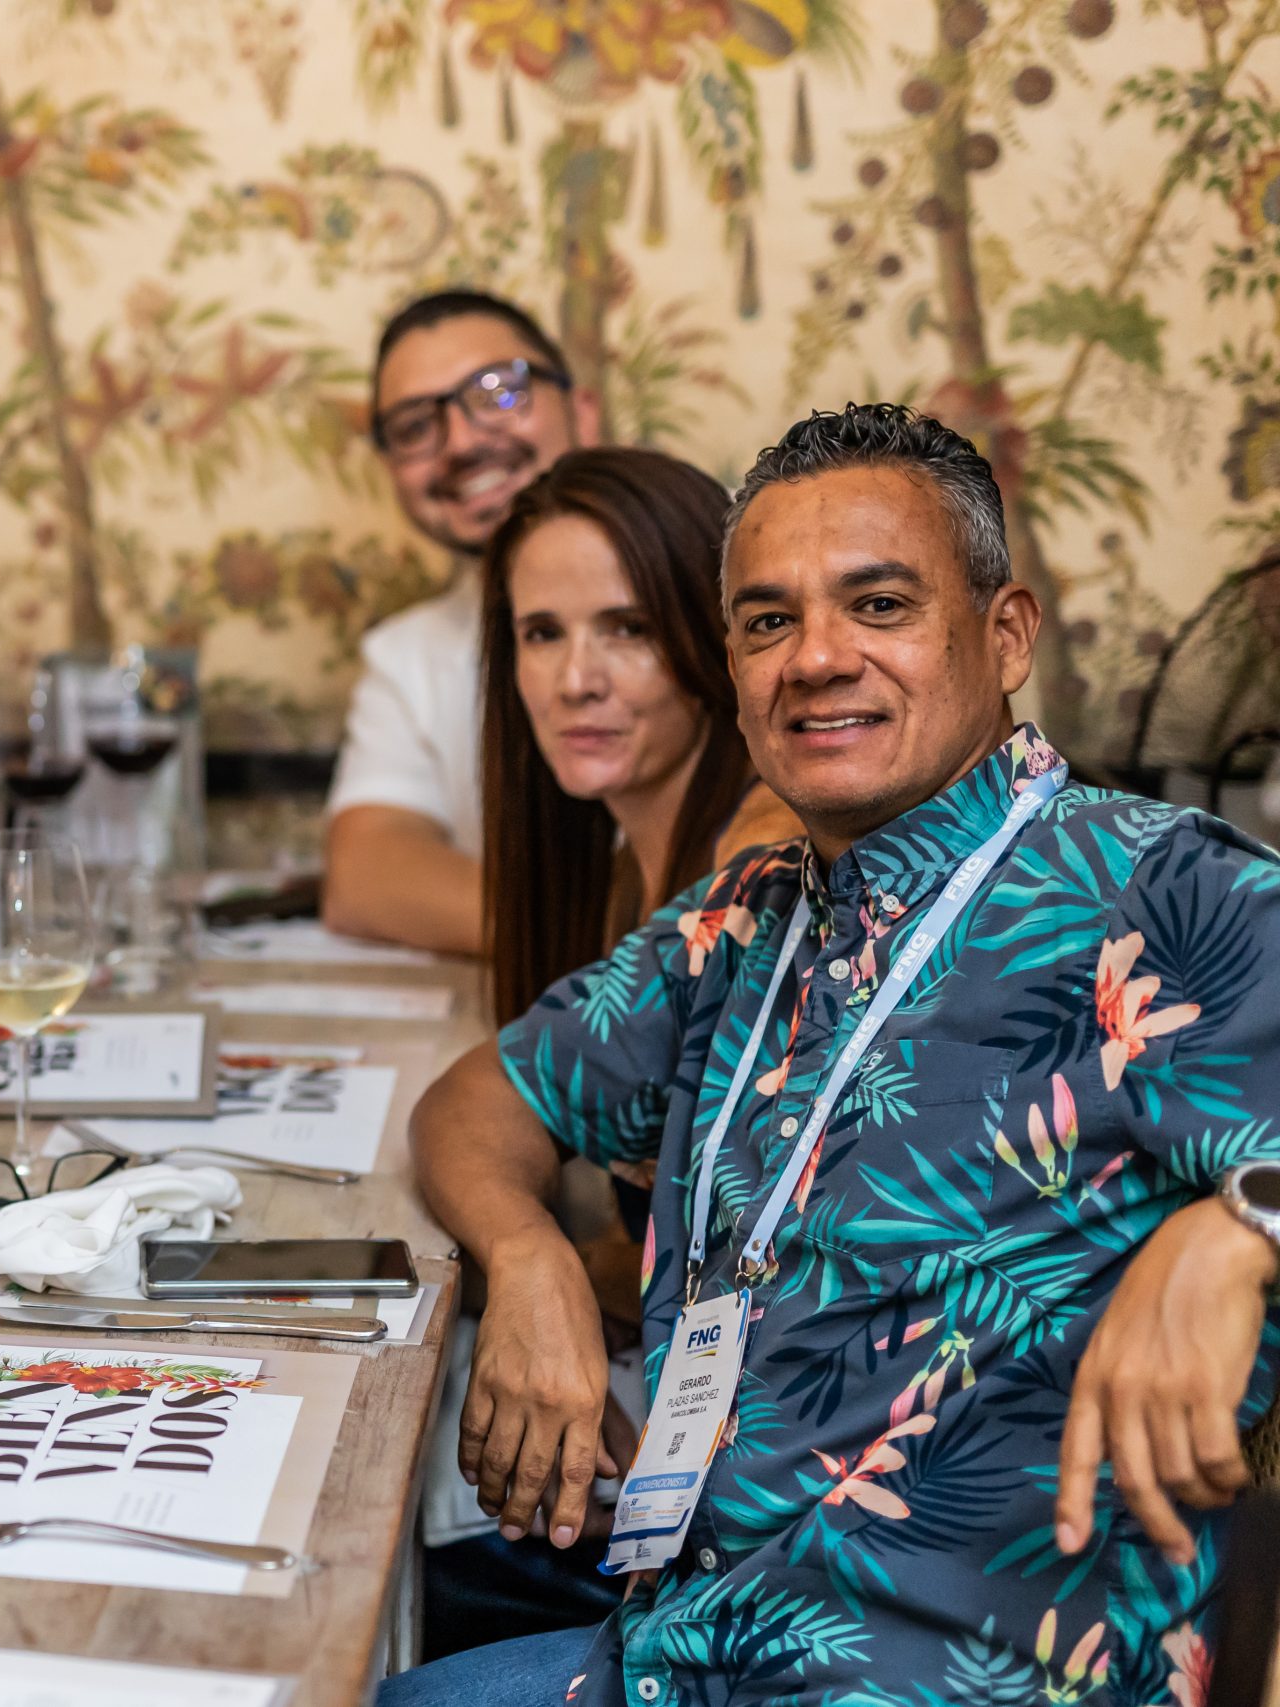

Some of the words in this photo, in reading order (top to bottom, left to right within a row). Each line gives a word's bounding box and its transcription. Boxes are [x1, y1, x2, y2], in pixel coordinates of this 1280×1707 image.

[1001, 791, 1037, 832] FNG
[944, 856, 983, 901] FNG
[892, 931, 929, 982] FNG
[841, 1015, 876, 1065] FNG
[799, 1101, 826, 1154] FNG
[687, 1324, 721, 1349] FNG
[666, 1395, 690, 1409] PLAZAS
[690, 1388, 720, 1404] SANCHEZ
[679, 1374, 712, 1392] GERARDO
[132, 1389, 239, 1478] DOS
